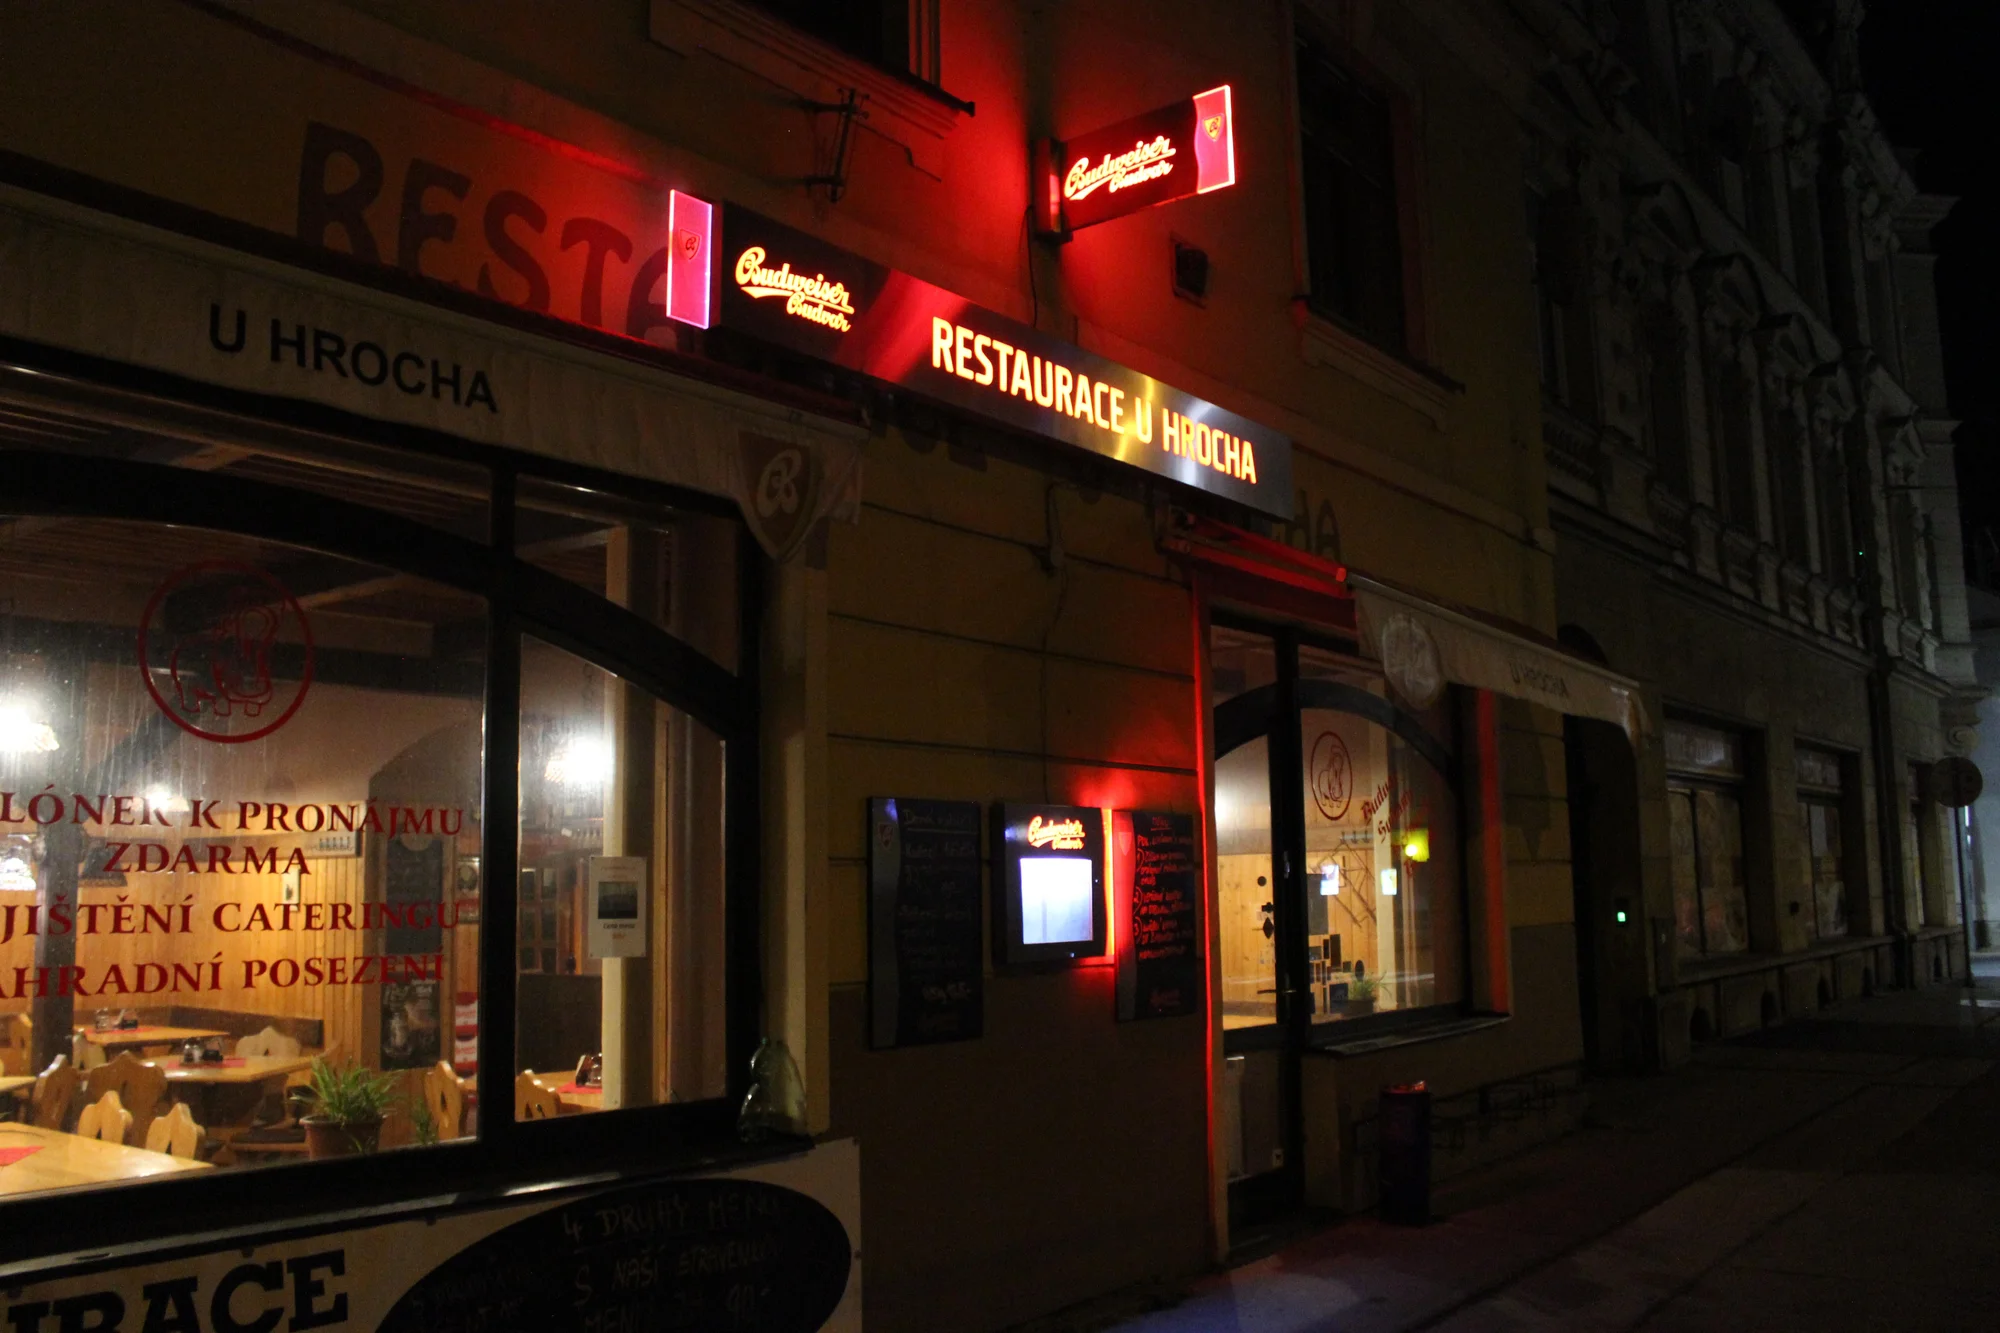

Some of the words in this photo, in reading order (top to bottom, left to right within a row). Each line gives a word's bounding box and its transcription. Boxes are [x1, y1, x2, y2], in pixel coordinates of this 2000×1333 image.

[1063, 135, 1176, 198] Budweiser
[1108, 160, 1174, 193] Budvar
[735, 246, 854, 308] Budweiser
[786, 291, 851, 332] Budvar
[209, 303, 246, 353] U
[270, 318, 498, 413] HROCHA
[932, 316, 1125, 434] RESTAURACE
[1135, 396, 1154, 444] U
[1161, 407, 1257, 485] HROCHA
[188, 799, 222, 829] K
[237, 797, 464, 840] PRONÁJMU
[102, 841, 312, 876] ZDARMA
[213, 902, 461, 933] CATERINGU
[242, 947, 446, 990] POSEZENÍ
